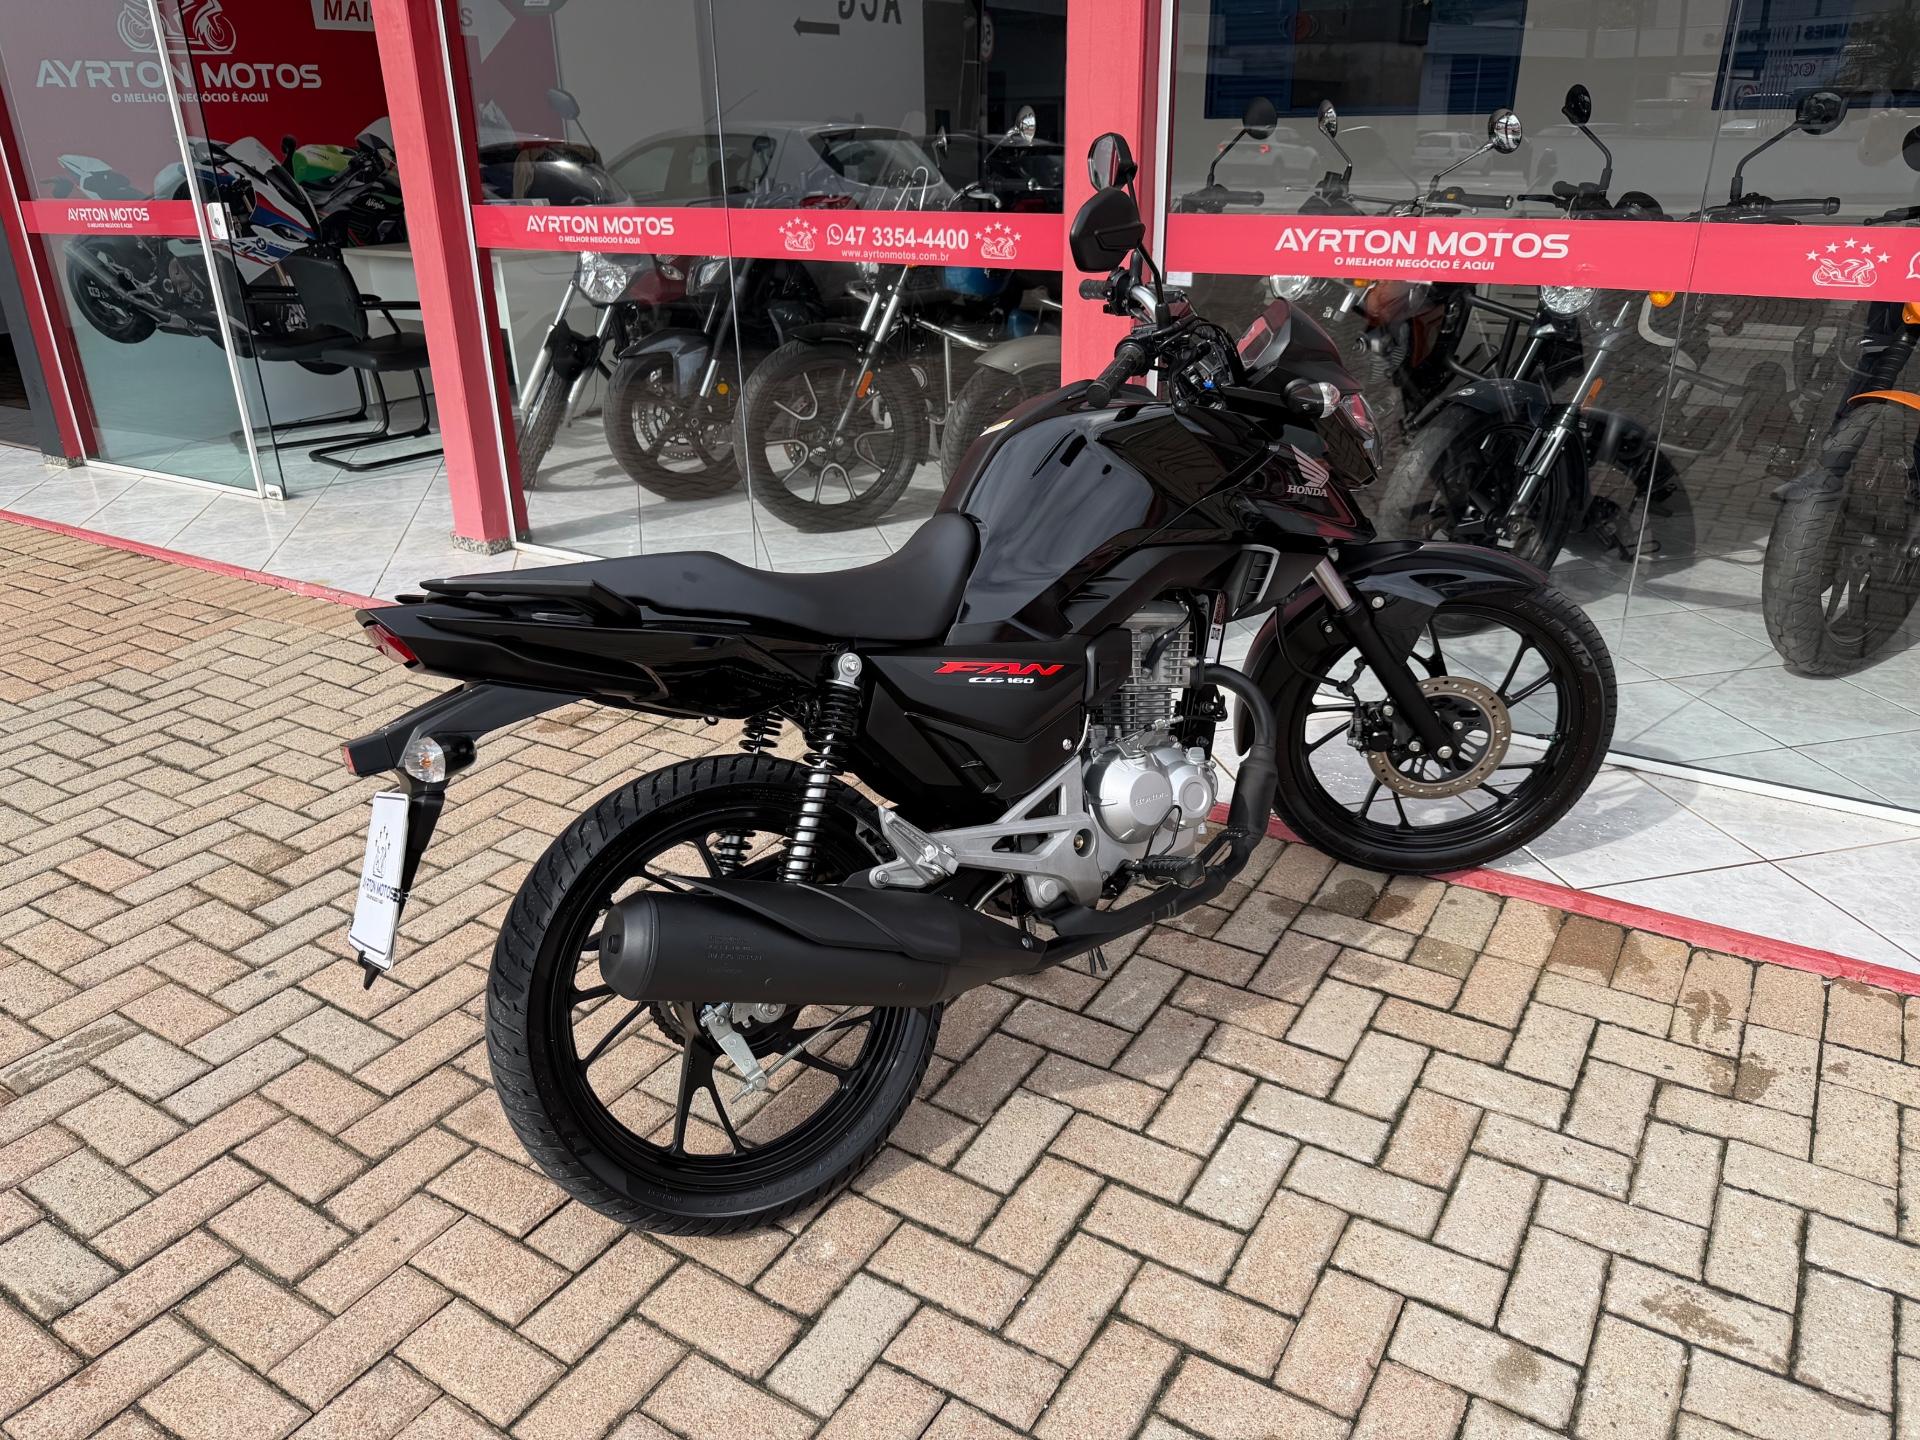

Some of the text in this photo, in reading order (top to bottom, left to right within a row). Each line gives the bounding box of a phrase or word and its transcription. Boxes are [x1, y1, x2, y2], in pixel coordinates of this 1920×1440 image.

[323, 0, 374, 22] MAI
[36, 59, 322, 89] AYRTON MOTOS
[111, 92, 122, 103] O
[124, 92, 168, 103] MELHO
[232, 91, 239, 103] É
[241, 93, 269, 103] AQUI
[68, 207, 150, 221] AYRTON MOTOS
[526, 214, 675, 236] AYRTON MOTOS
[844, 226, 970, 250] 47 3354-4400
[1274, 227, 1570, 259] AYRTON MOTOS
[841, 247, 950, 262] www.ayrtonmotos.com.br
[1334, 256, 1495, 271] O MELHOR NEGÓCIO É AQUI
[1286, 484, 1329, 498] HONDA
[934, 661, 1065, 676] FAN
